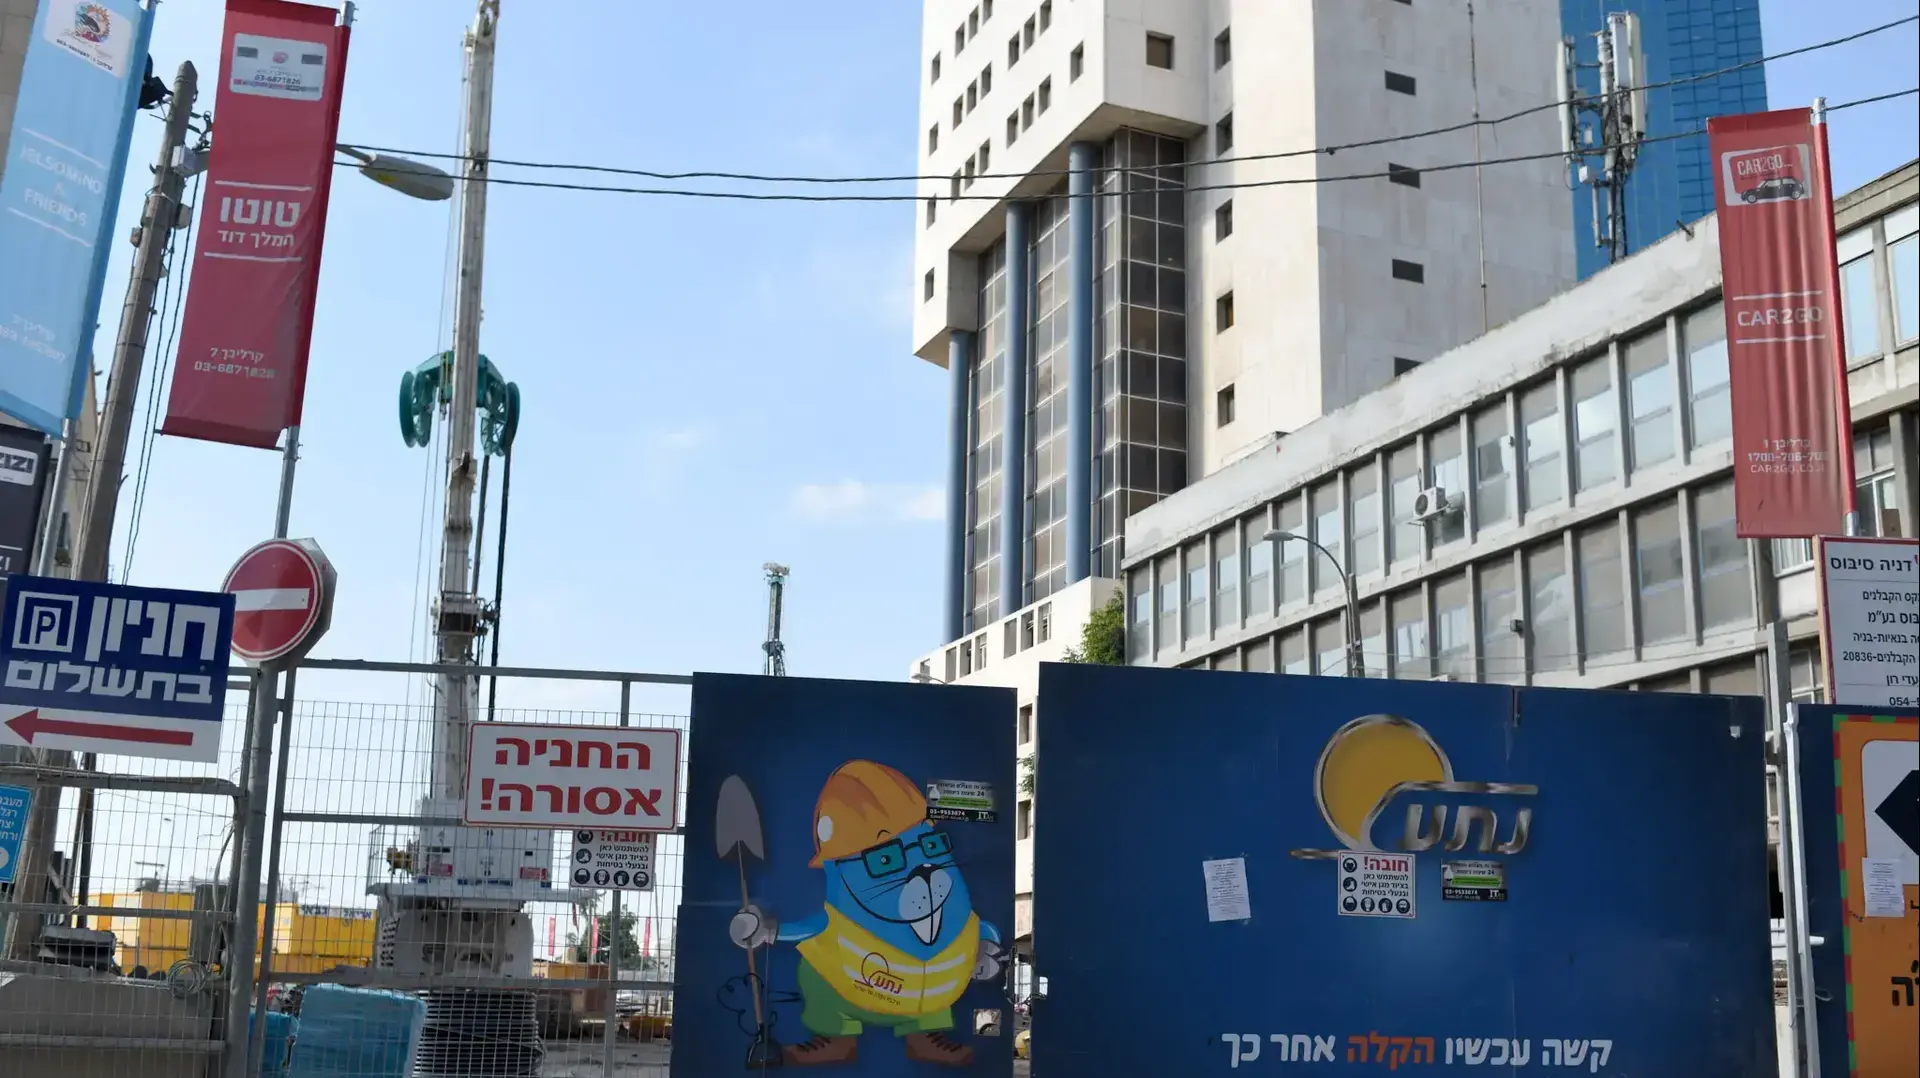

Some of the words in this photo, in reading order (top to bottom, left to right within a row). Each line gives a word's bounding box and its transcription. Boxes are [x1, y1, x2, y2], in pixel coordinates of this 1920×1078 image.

[24, 187, 88, 227] FRIENDS
[220, 197, 301, 228] טוטו
[217, 229, 246, 244] דוד
[250, 231, 295, 249] המלך
[1737, 306, 1823, 327] CAR2GO
[210, 347, 218, 357] 7
[221, 348, 264, 364] קרליבך
[1830, 556, 1874, 571] סיבוס
[1880, 559, 1912, 572] דניה
[1862, 589, 1902, 606] הקבלנים
[1904, 592, 1919, 606] קס
[1867, 610, 1896, 624] בע"מ
[84, 596, 220, 662] חניון
[1853, 632, 1908, 645] בנאיות-בניה
[1842, 651, 1916, 666] הקבלנים-20836
[4, 660, 213, 704] בתשלום
[1886, 675, 1899, 687] רון
[1902, 675, 1919, 686] עדי
[495, 737, 651, 770] החניה
[480, 778, 662, 817] אסורה!
[0, 831, 18, 841] ורח
[1396, 803, 1532, 855] נתע
[601, 831, 650, 843] חובה!
[599, 844, 612, 852] כאן
[614, 845, 649, 853] להשתמש
[596, 852, 613, 860] אישי
[596, 860, 623, 869] בטיחות
[625, 861, 649, 870] ובנעלי
[1364, 856, 1409, 872] חובה!
[1388, 889, 1409, 897] ובנעלי
[874, 975, 903, 995] נתע
[1222, 1033, 1261, 1068] כך
[1270, 1034, 1336, 1062] אחר
[1347, 1030, 1435, 1071] הקלה
[1445, 1036, 1530, 1066] עכשיו
[1541, 1038, 1613, 1073] קשה
